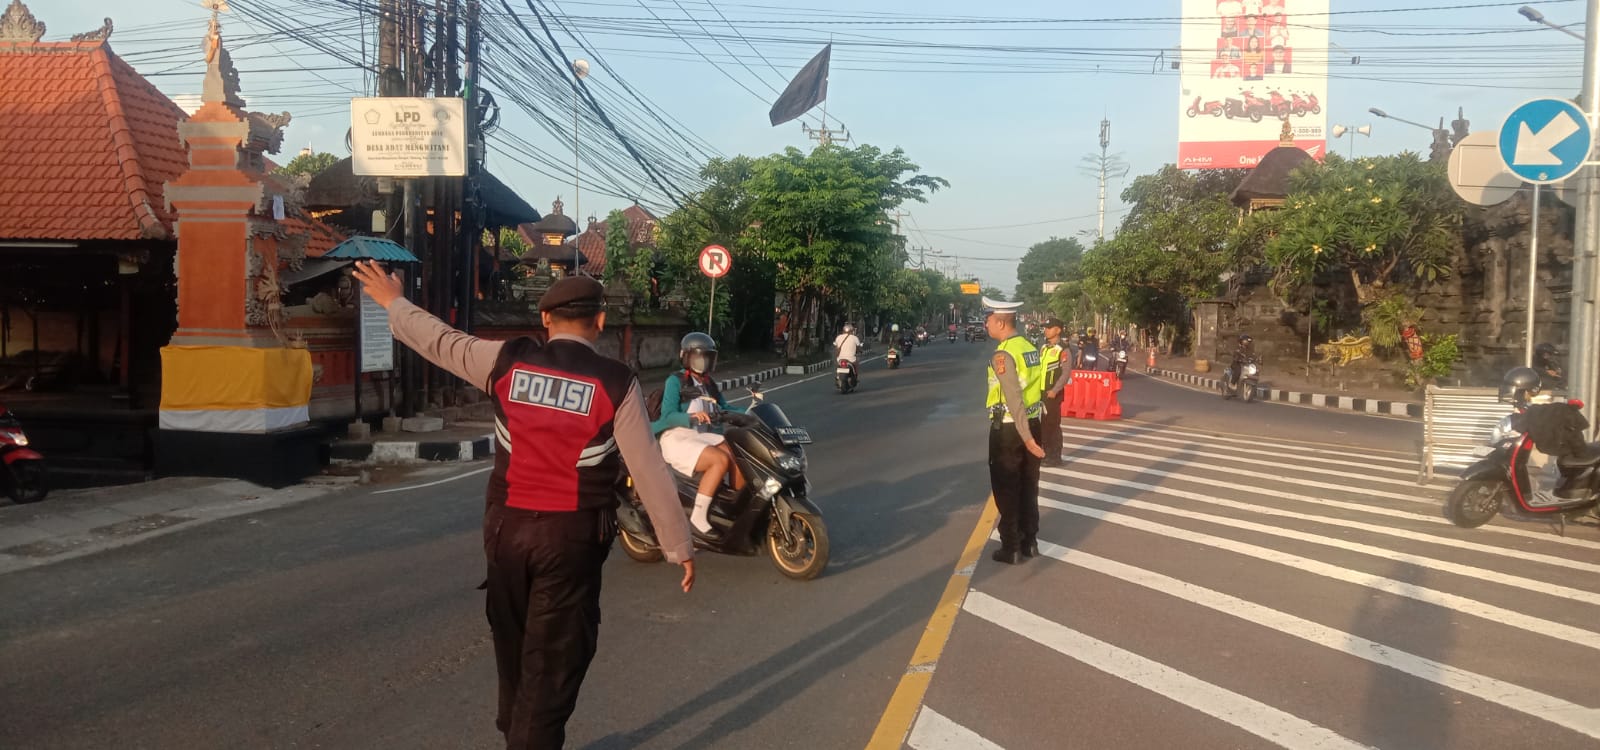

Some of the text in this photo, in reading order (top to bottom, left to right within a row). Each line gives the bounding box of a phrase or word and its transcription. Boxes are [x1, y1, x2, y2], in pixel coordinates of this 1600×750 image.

[395, 112, 421, 122] LPD
[1240, 156, 1256, 164] One
[511, 372, 592, 413] POLISI
